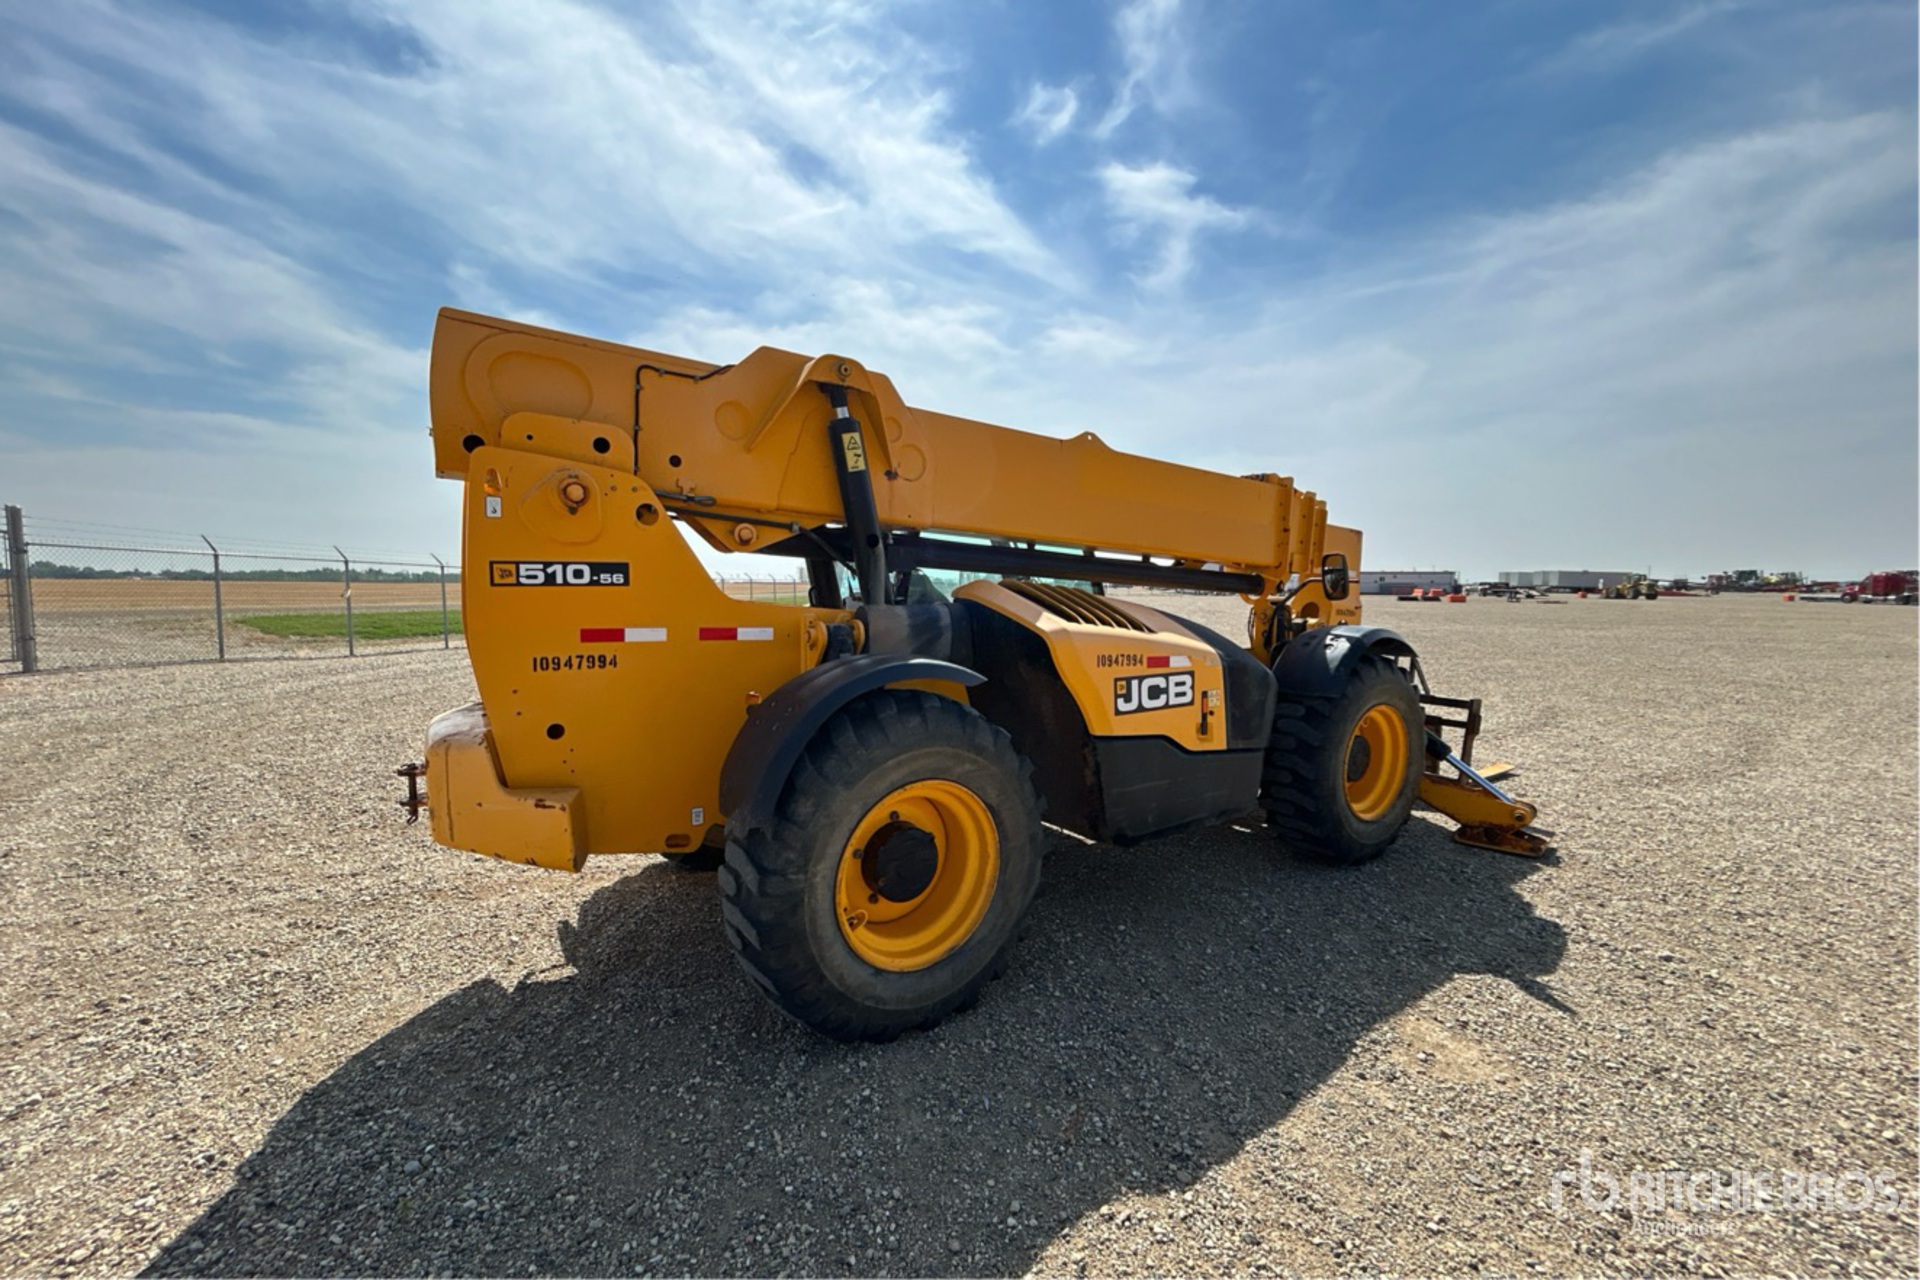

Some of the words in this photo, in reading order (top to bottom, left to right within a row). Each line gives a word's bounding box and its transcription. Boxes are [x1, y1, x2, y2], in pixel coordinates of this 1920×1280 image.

[533, 654, 618, 672] 10947994
[1096, 654, 1144, 668] 10947994
[1116, 674, 1193, 712] JCB
